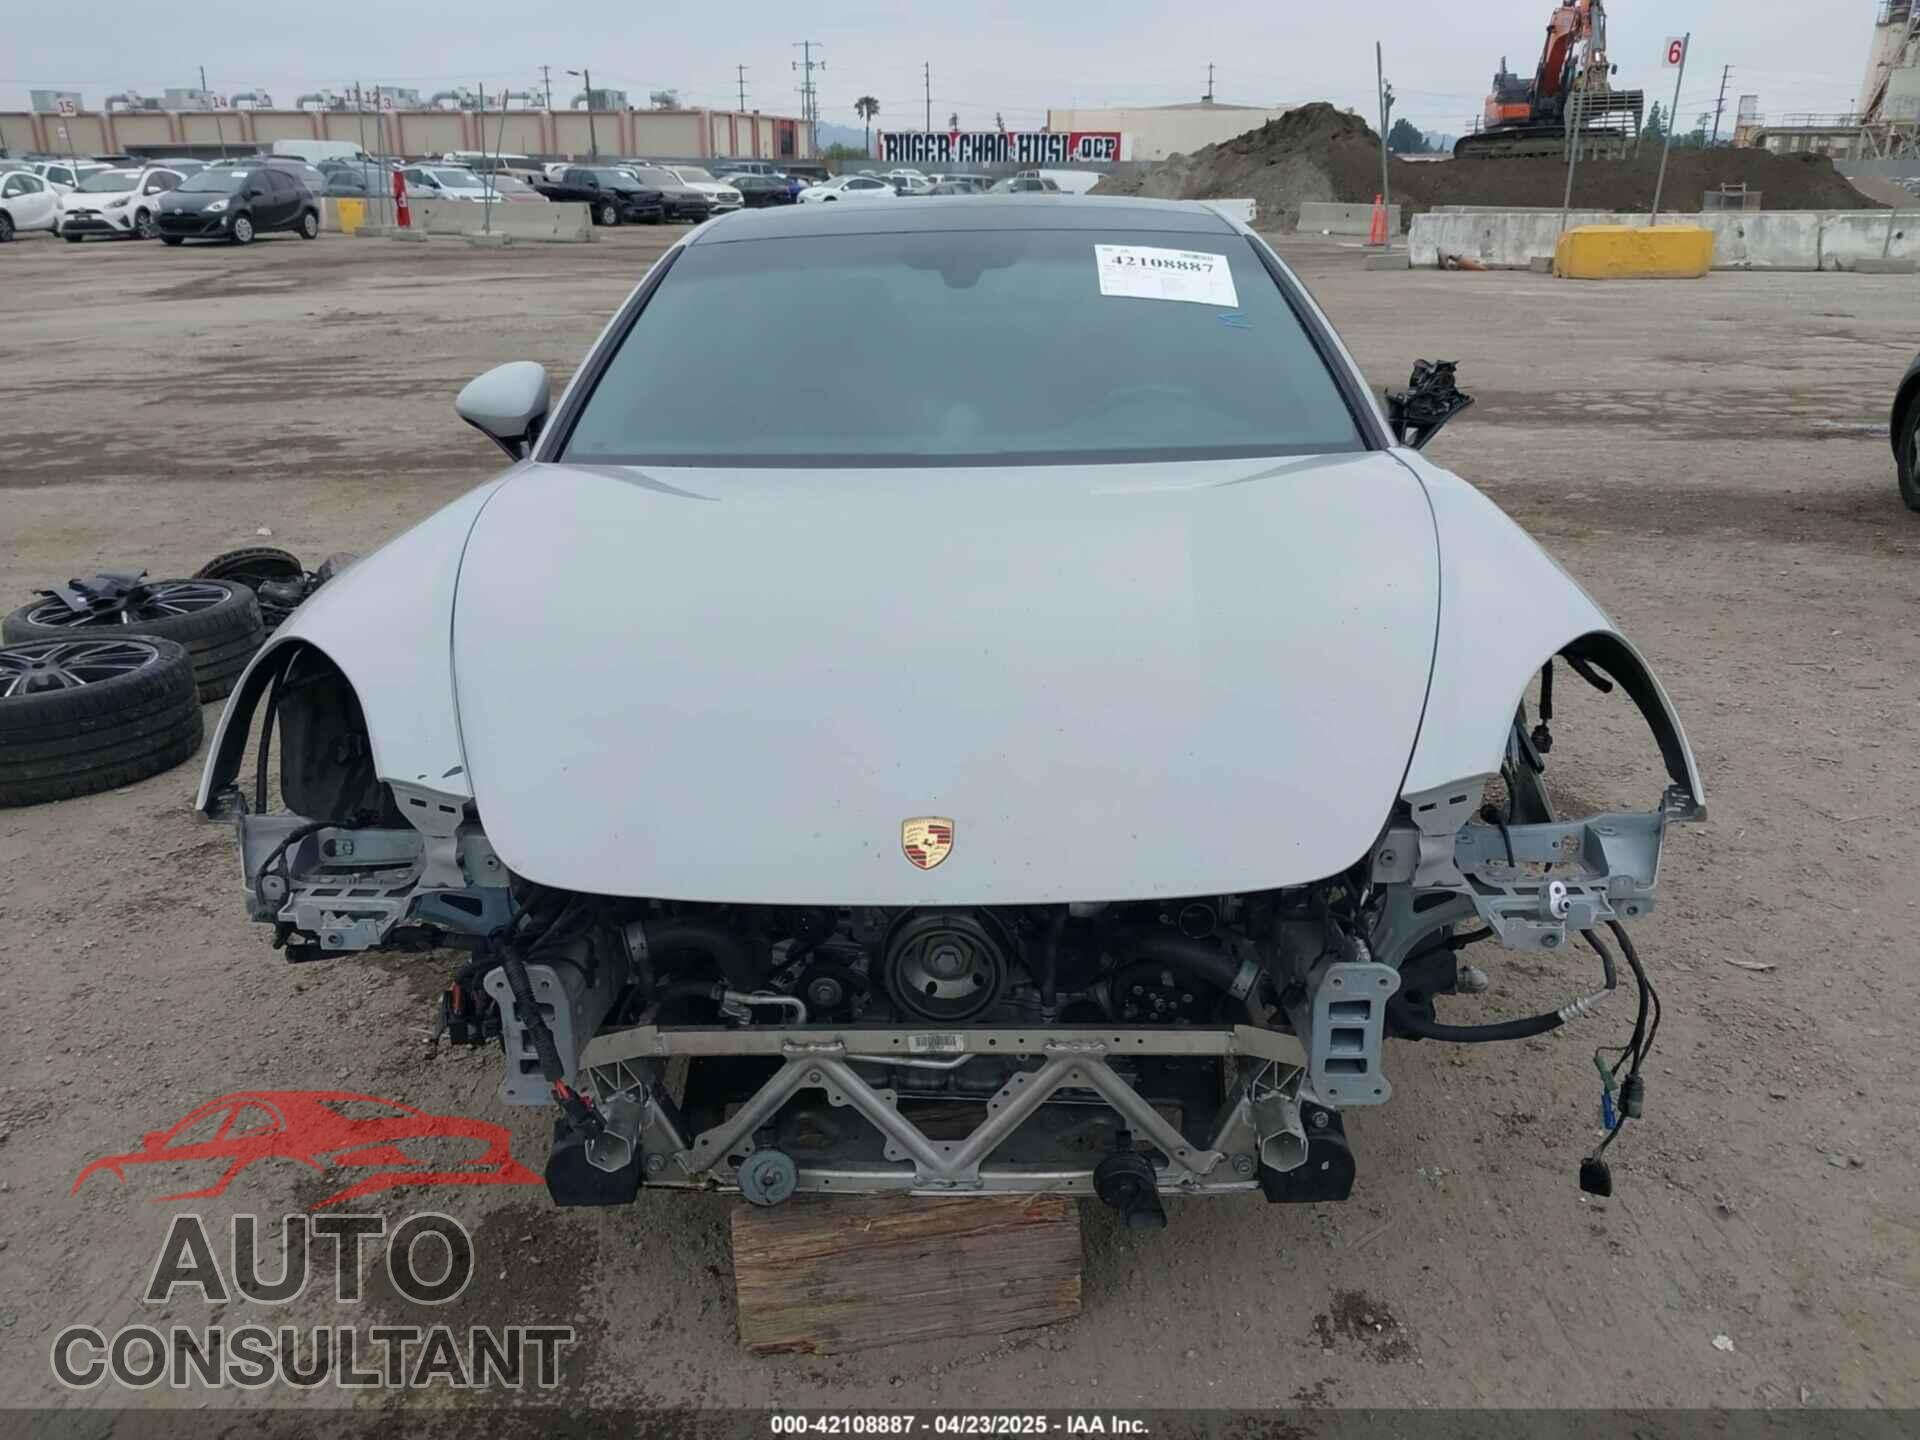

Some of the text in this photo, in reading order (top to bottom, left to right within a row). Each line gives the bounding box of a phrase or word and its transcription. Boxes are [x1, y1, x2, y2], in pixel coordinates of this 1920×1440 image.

[1669, 40, 1682, 64] 6
[59, 101, 74, 113] 15
[1112, 255, 1213, 273] 42108887
